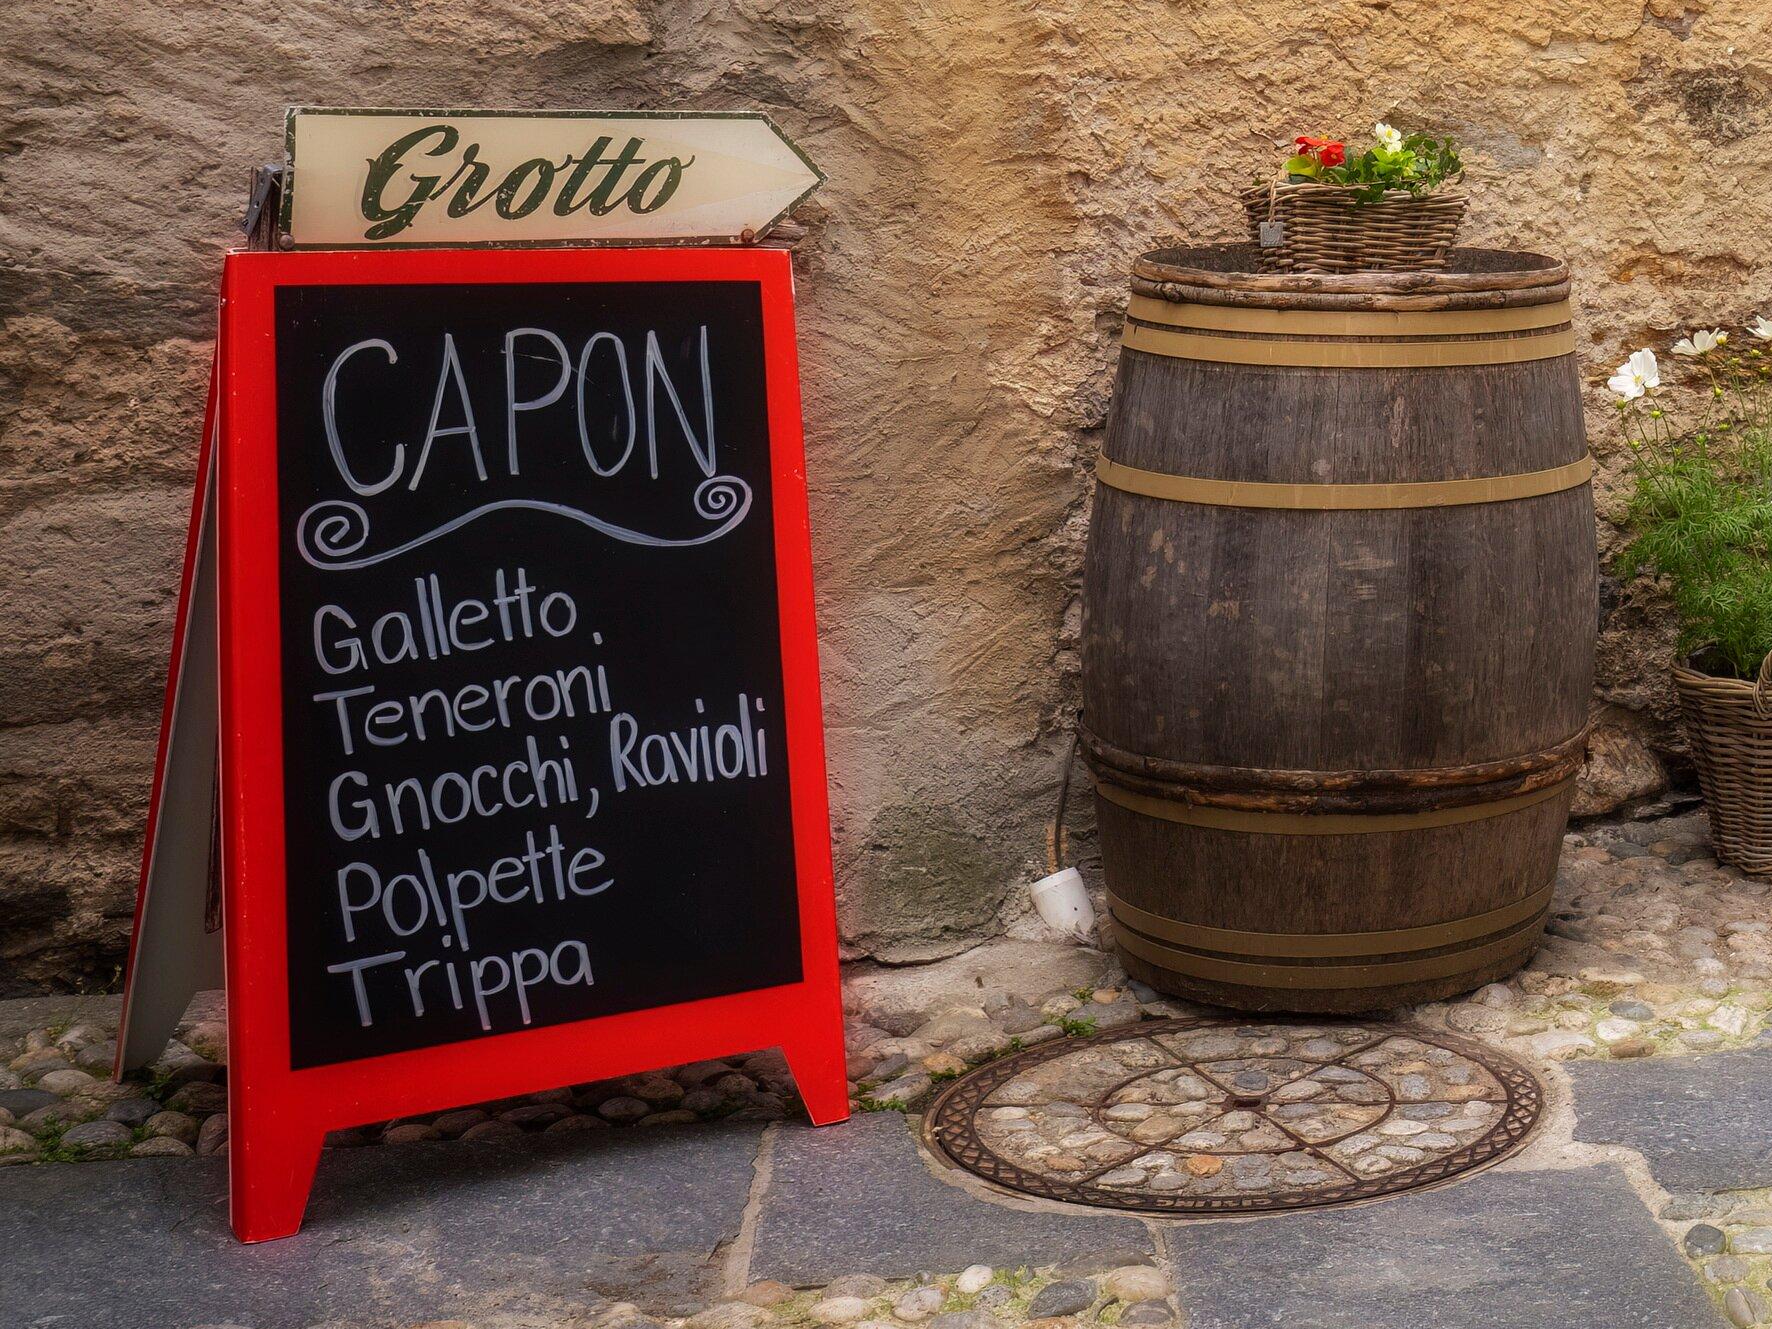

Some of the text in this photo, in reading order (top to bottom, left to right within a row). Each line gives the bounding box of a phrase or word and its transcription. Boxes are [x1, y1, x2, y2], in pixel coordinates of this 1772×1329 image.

[359, 124, 695, 240] Grotto
[322, 325, 716, 496] CAPON
[313, 568, 577, 674] Galletto
[313, 631, 612, 755] Teneroni
[328, 693, 768, 842] Gnocchi, Ravioli
[338, 825, 615, 951] Polpette
[327, 934, 595, 1030] Trippa
